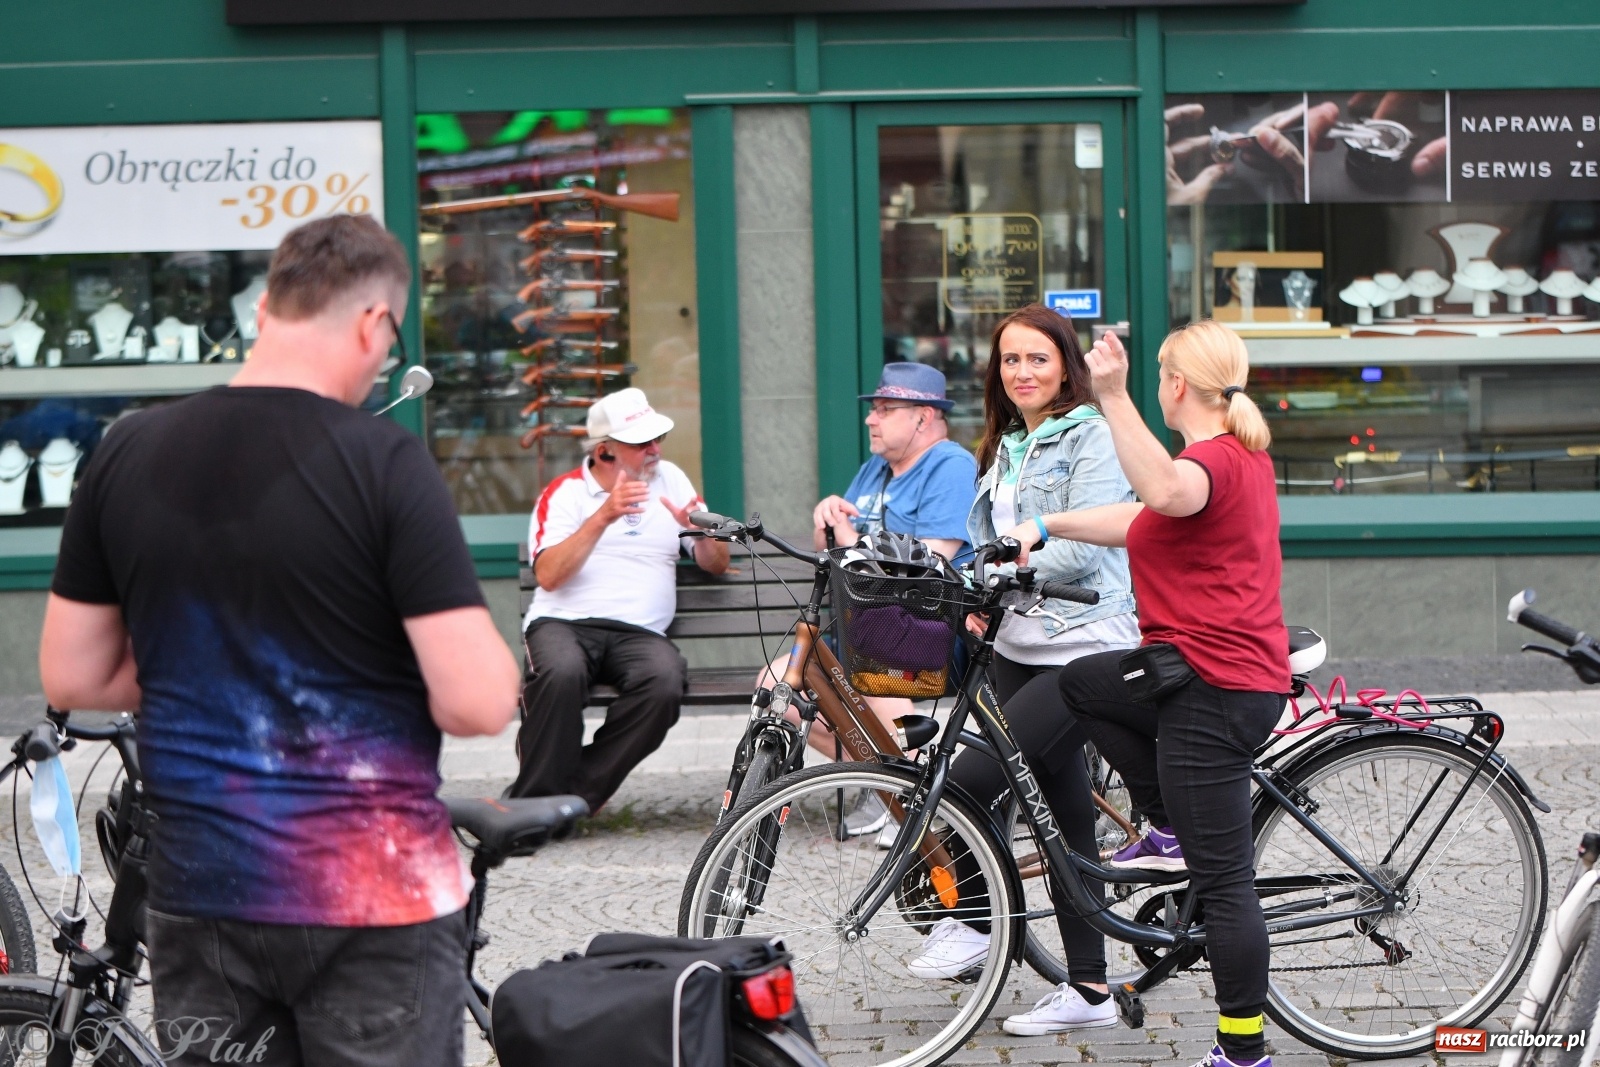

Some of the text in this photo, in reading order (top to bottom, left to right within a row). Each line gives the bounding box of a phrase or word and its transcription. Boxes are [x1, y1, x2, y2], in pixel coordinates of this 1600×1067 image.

[1461, 115, 1600, 133] NAPRAWA B
[84, 147, 316, 192] Obrączki do
[1461, 160, 1552, 178] SERWIS
[219, 172, 370, 229] -30%
[830, 666, 860, 705] GAZELA
[1007, 750, 1060, 841] MAXIM
